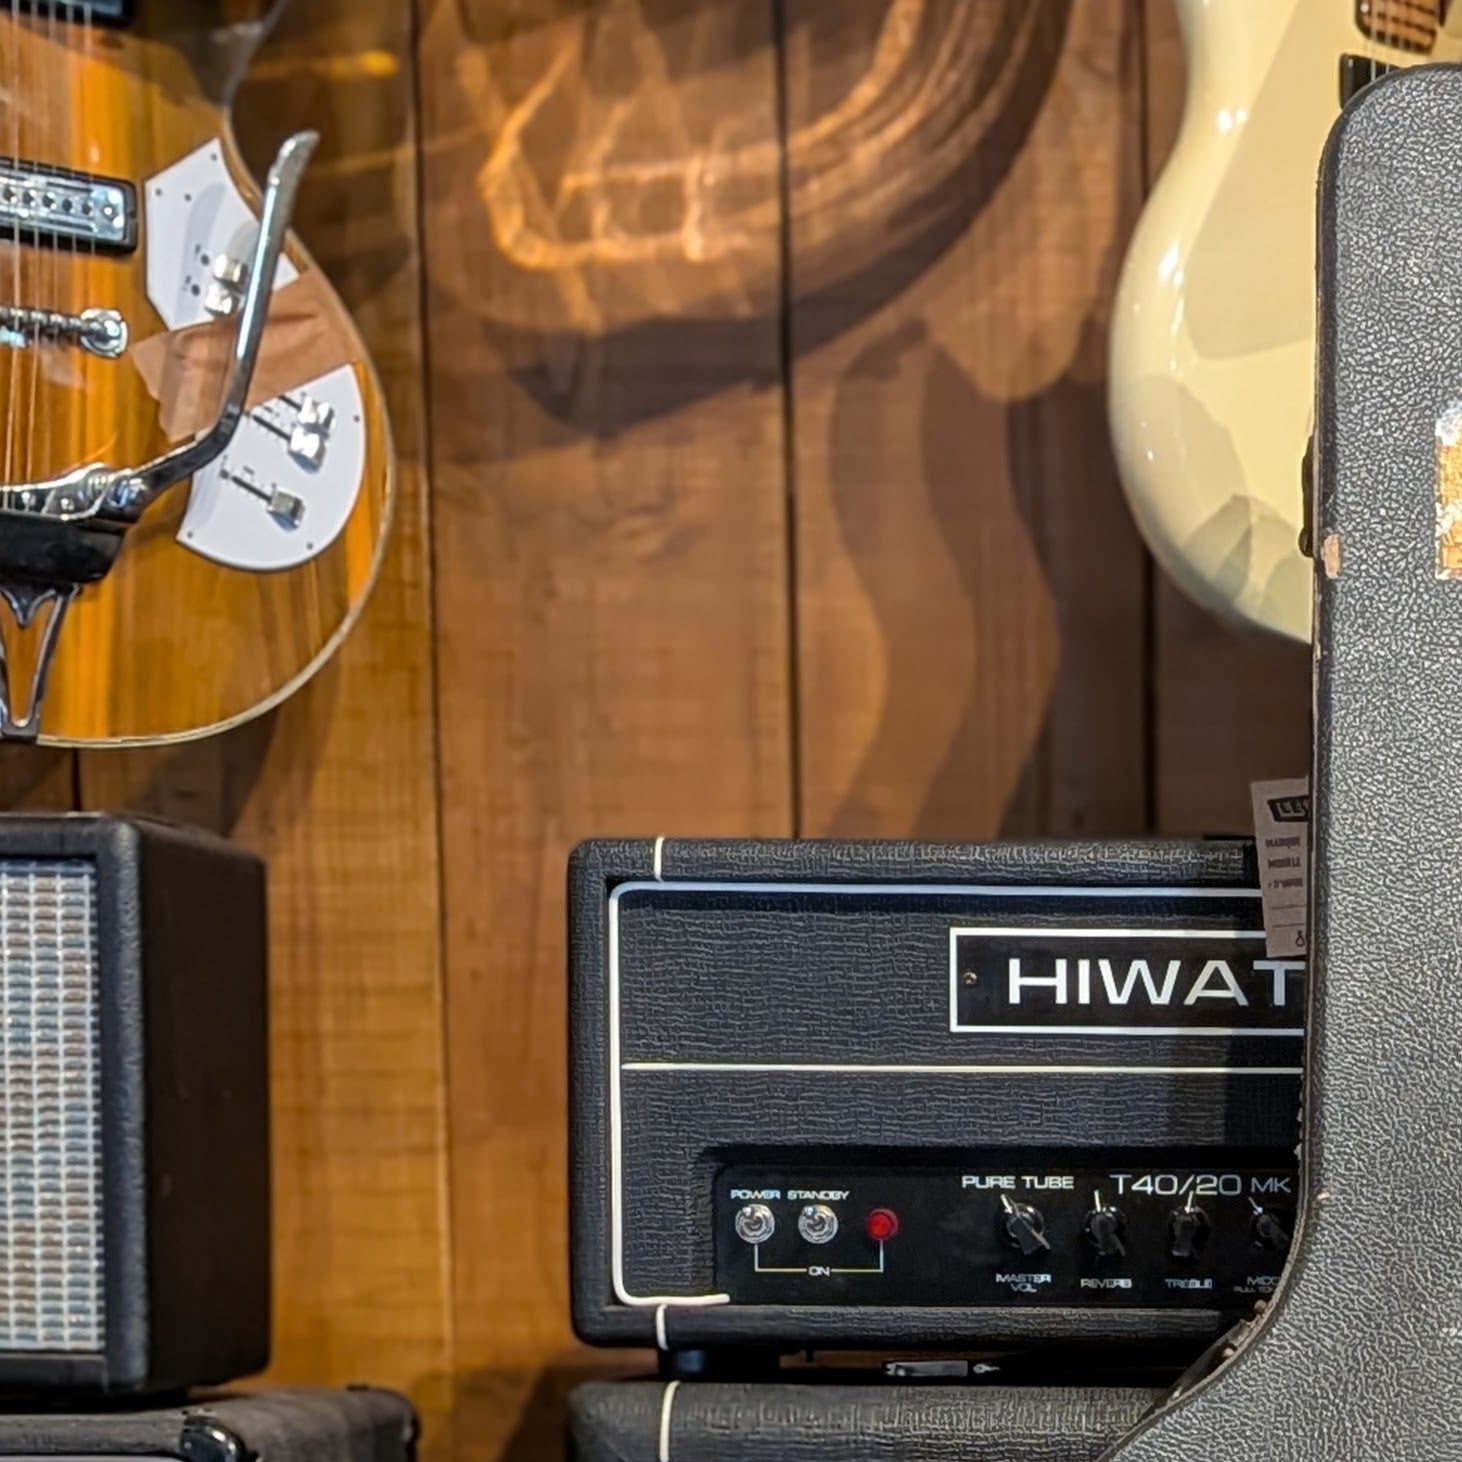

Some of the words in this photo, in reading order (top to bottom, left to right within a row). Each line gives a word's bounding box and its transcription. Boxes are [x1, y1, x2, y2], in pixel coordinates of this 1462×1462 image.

[961, 1175, 1016, 1190] PURE
[1021, 1175, 1074, 1190] TUBE
[1109, 1174, 1242, 1196] T40/20
[730, 1189, 782, 1200] POWER
[786, 1189, 851, 1200] STANDBY
[808, 1265, 830, 1277] ON
[995, 1273, 1052, 1283] MASTER
[1080, 1278, 1133, 1289] REVERB
[1164, 1278, 1213, 1289] TREBLE
[1011, 1283, 1037, 1293] VOL
